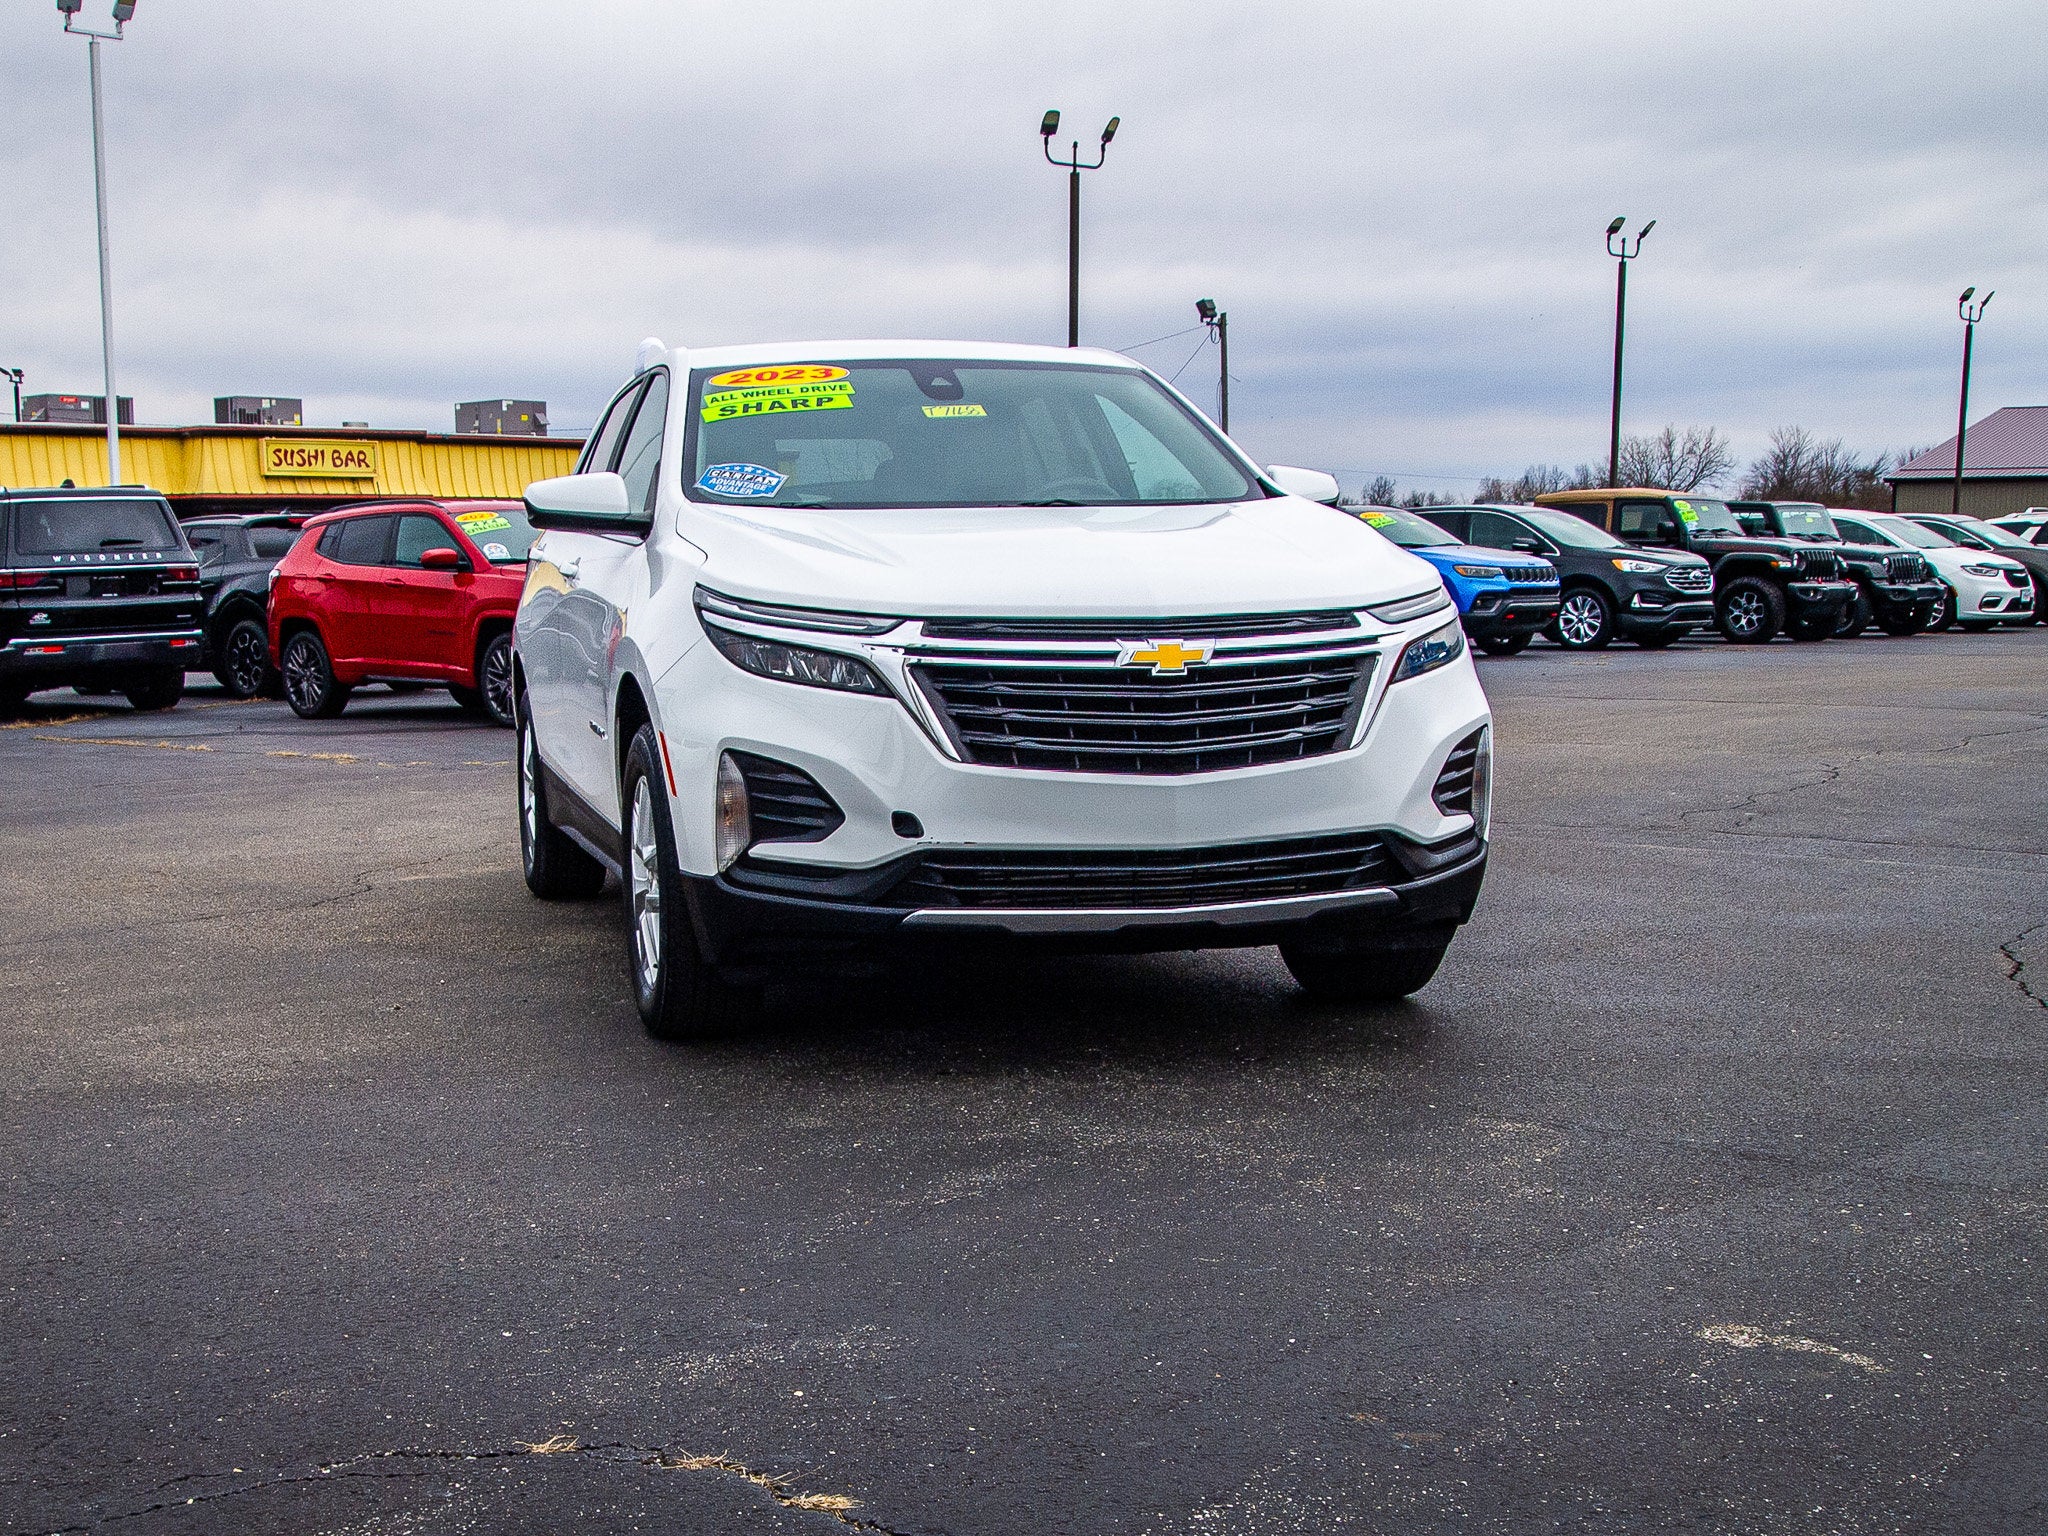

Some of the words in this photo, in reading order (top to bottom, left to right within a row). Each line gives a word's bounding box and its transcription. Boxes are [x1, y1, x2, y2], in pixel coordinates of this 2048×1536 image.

[726, 367, 833, 386] 2023
[710, 393, 738, 404] ALL
[741, 388, 795, 398] WHEEL
[800, 384, 848, 394] DRIVE
[718, 397, 834, 417] SHARP
[272, 448, 325, 467] SUSHI
[331, 449, 371, 468] BAR
[708, 477, 768, 491] ADVANTAGE
[709, 469, 779, 486] CARFAX
[713, 485, 754, 495] DEALER
[52, 552, 162, 562] WAGONEER
